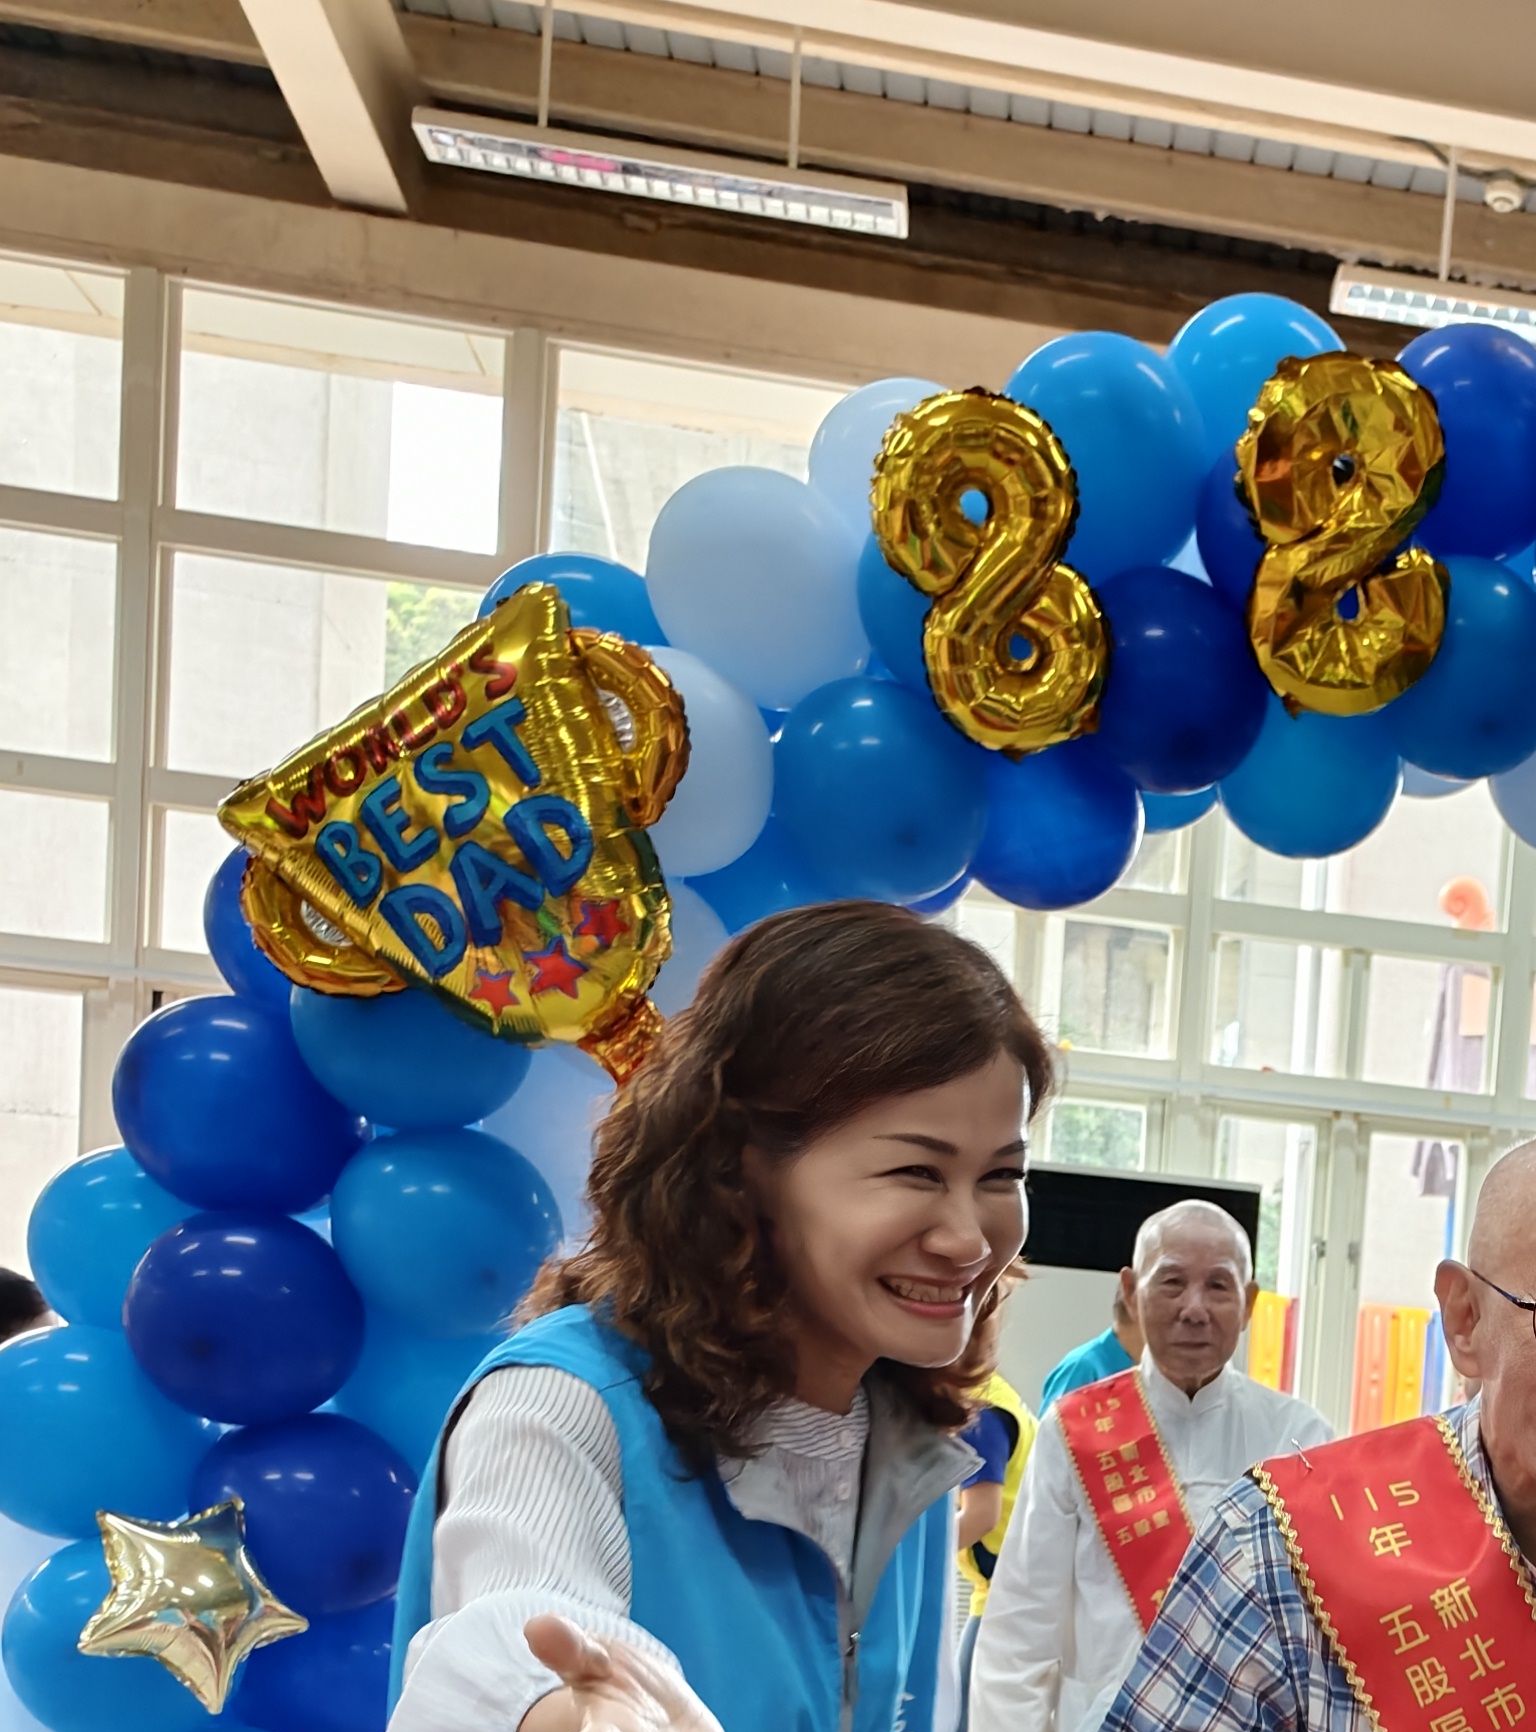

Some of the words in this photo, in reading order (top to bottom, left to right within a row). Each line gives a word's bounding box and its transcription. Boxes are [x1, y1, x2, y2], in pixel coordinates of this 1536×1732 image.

[265, 642, 518, 838] WORLD'S
[315, 698, 542, 909] BEST
[379, 793, 594, 978] DAD
[1430, 1577, 1526, 1731] 新北市
